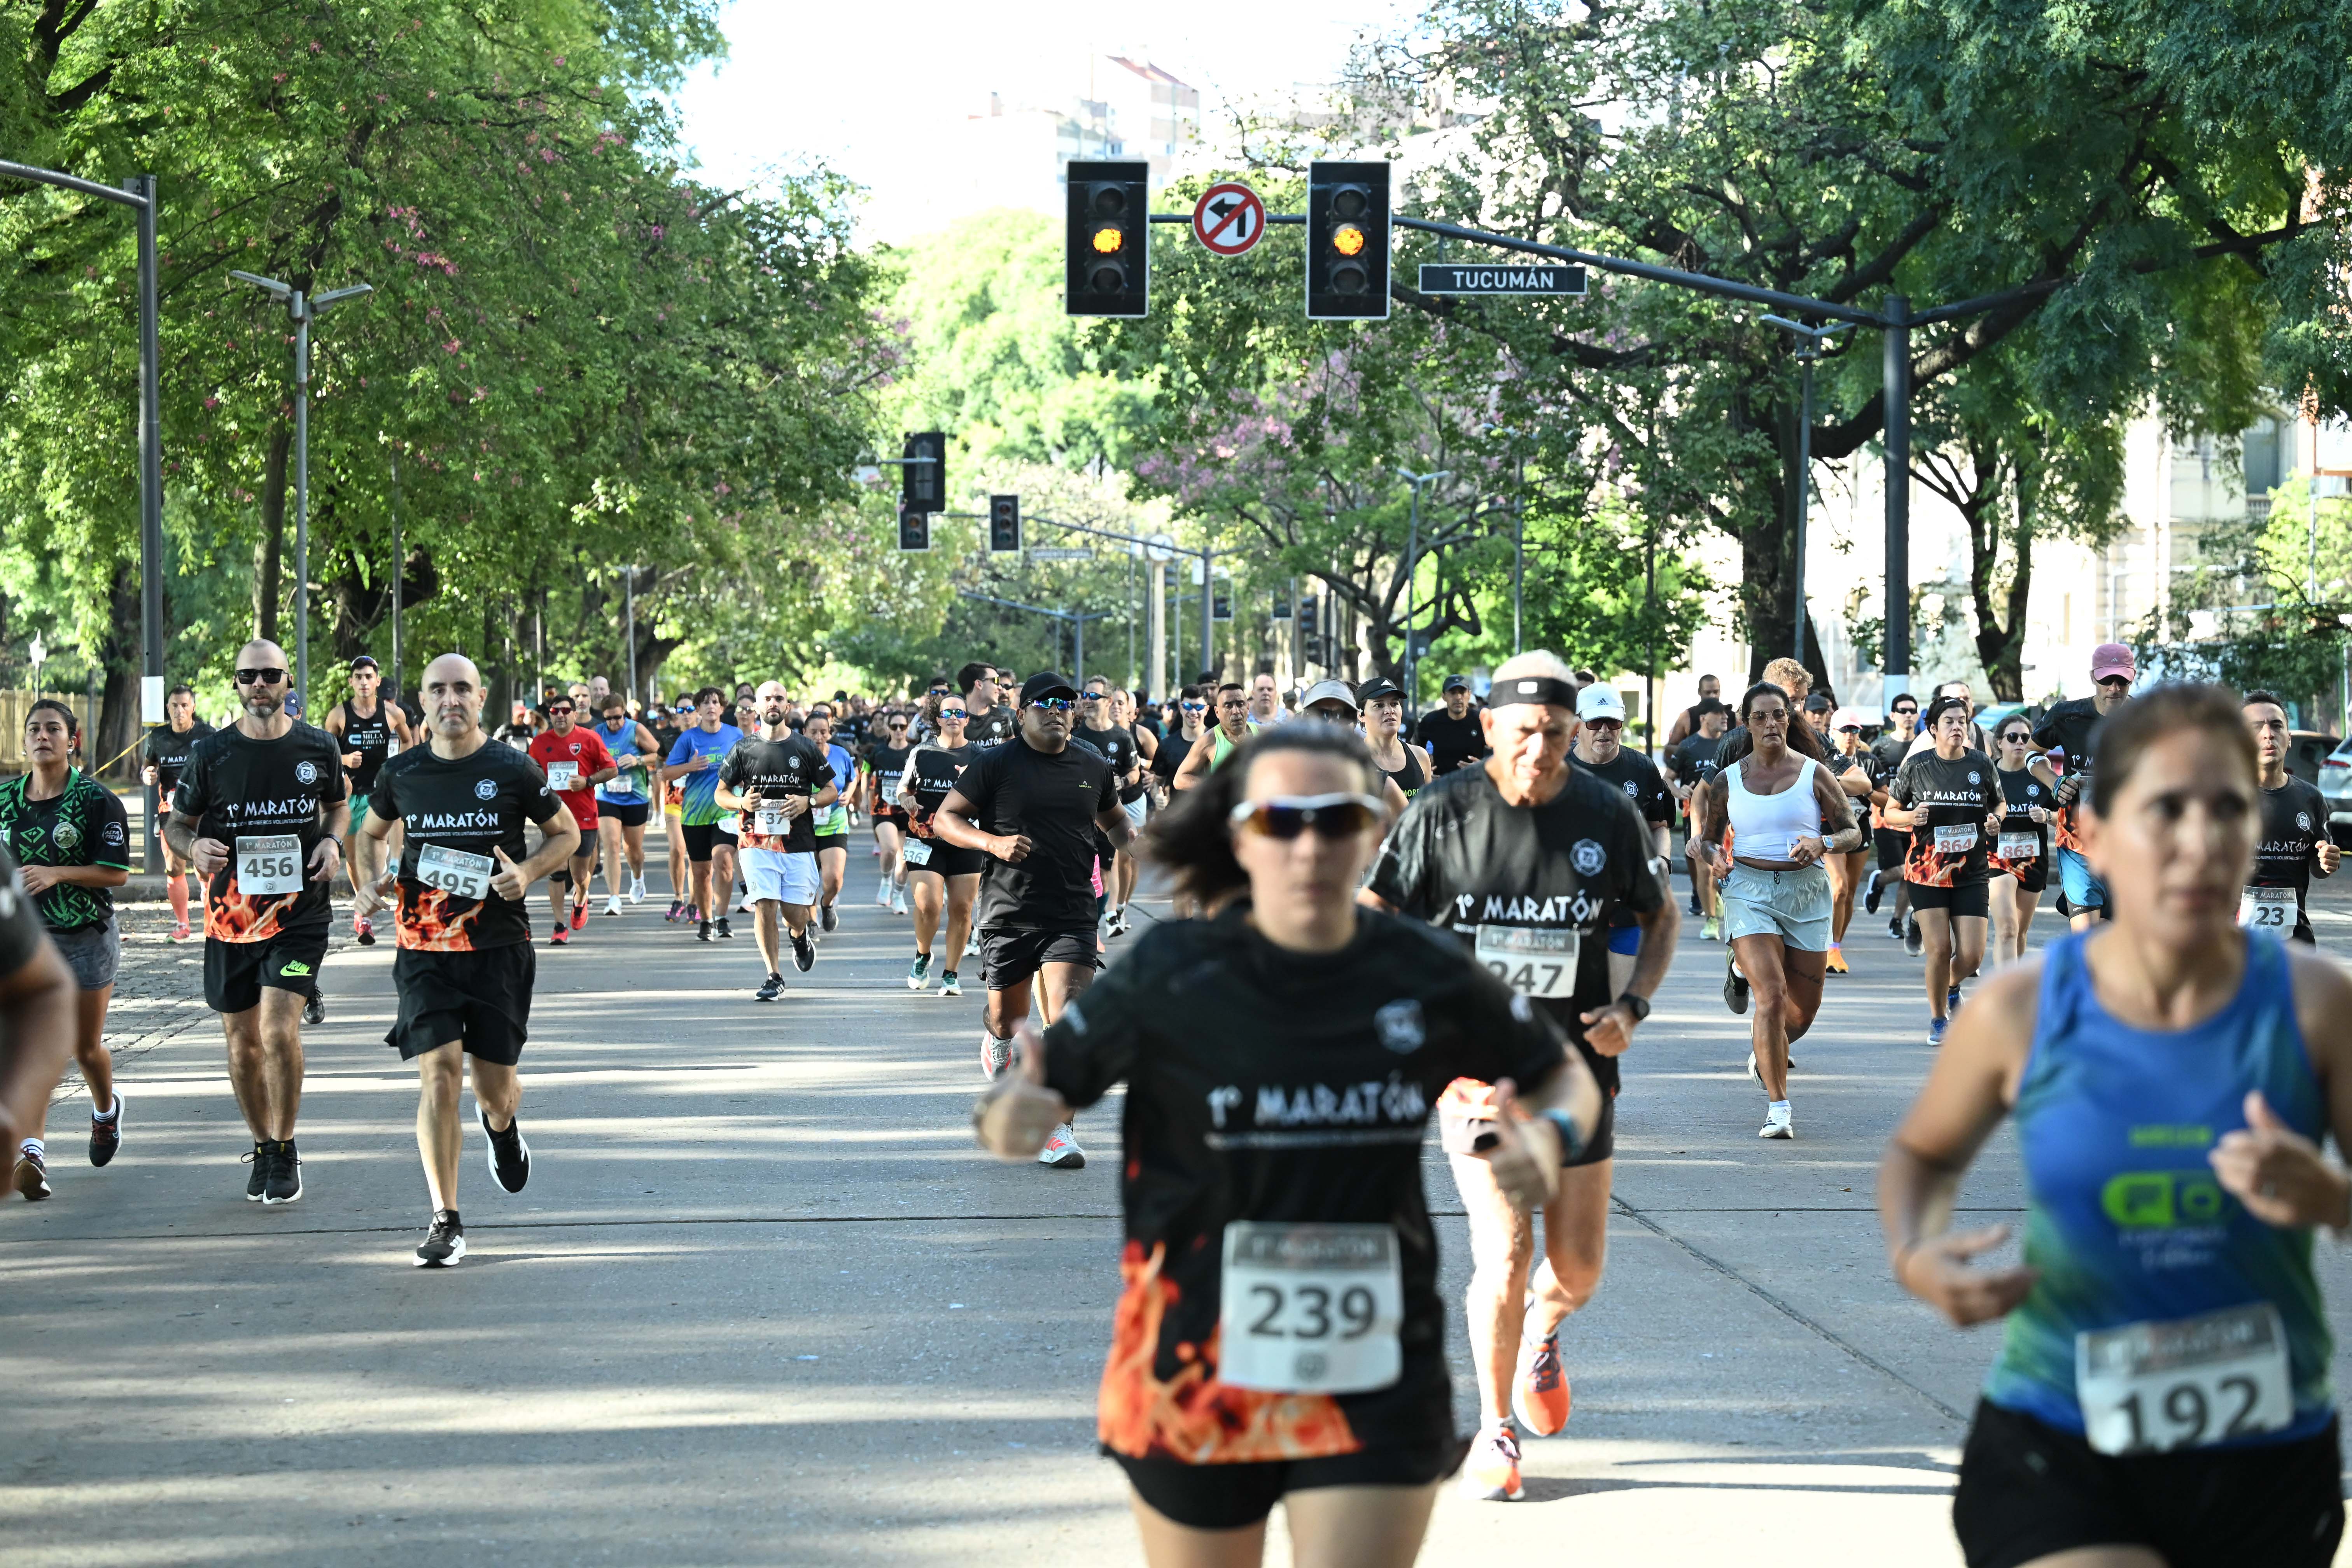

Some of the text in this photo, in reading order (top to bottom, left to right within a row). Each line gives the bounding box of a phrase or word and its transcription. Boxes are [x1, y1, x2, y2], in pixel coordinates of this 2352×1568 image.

[1452, 267, 1553, 288] TUCUMÁN
[973, 735, 1002, 746] ARATÓN
[555, 772, 569, 781] 37
[761, 772, 799, 784] MARATÓN
[1933, 789, 1981, 802] MARATÓN
[245, 794, 316, 817] MARATÓN
[422, 808, 498, 828] MARATÓN
[254, 839, 292, 849] MARATÓN
[1940, 838, 1972, 853] 864
[2003, 844, 2034, 859] 863
[2254, 838, 2309, 852] MARATÓN
[441, 853, 482, 868] MARATÓN
[903, 849, 923, 863] 536
[245, 857, 294, 878] 456
[425, 870, 478, 898] 495
[2260, 889, 2291, 899] MARATÓN
[1483, 889, 1603, 922] MARATÓN
[2255, 906, 2284, 926] 23
[287, 960, 310, 974] RUN
[1254, 1070, 1426, 1126] MARATÓN
[1248, 1284, 1376, 1340] 239
[2115, 1376, 2260, 1450] 192
